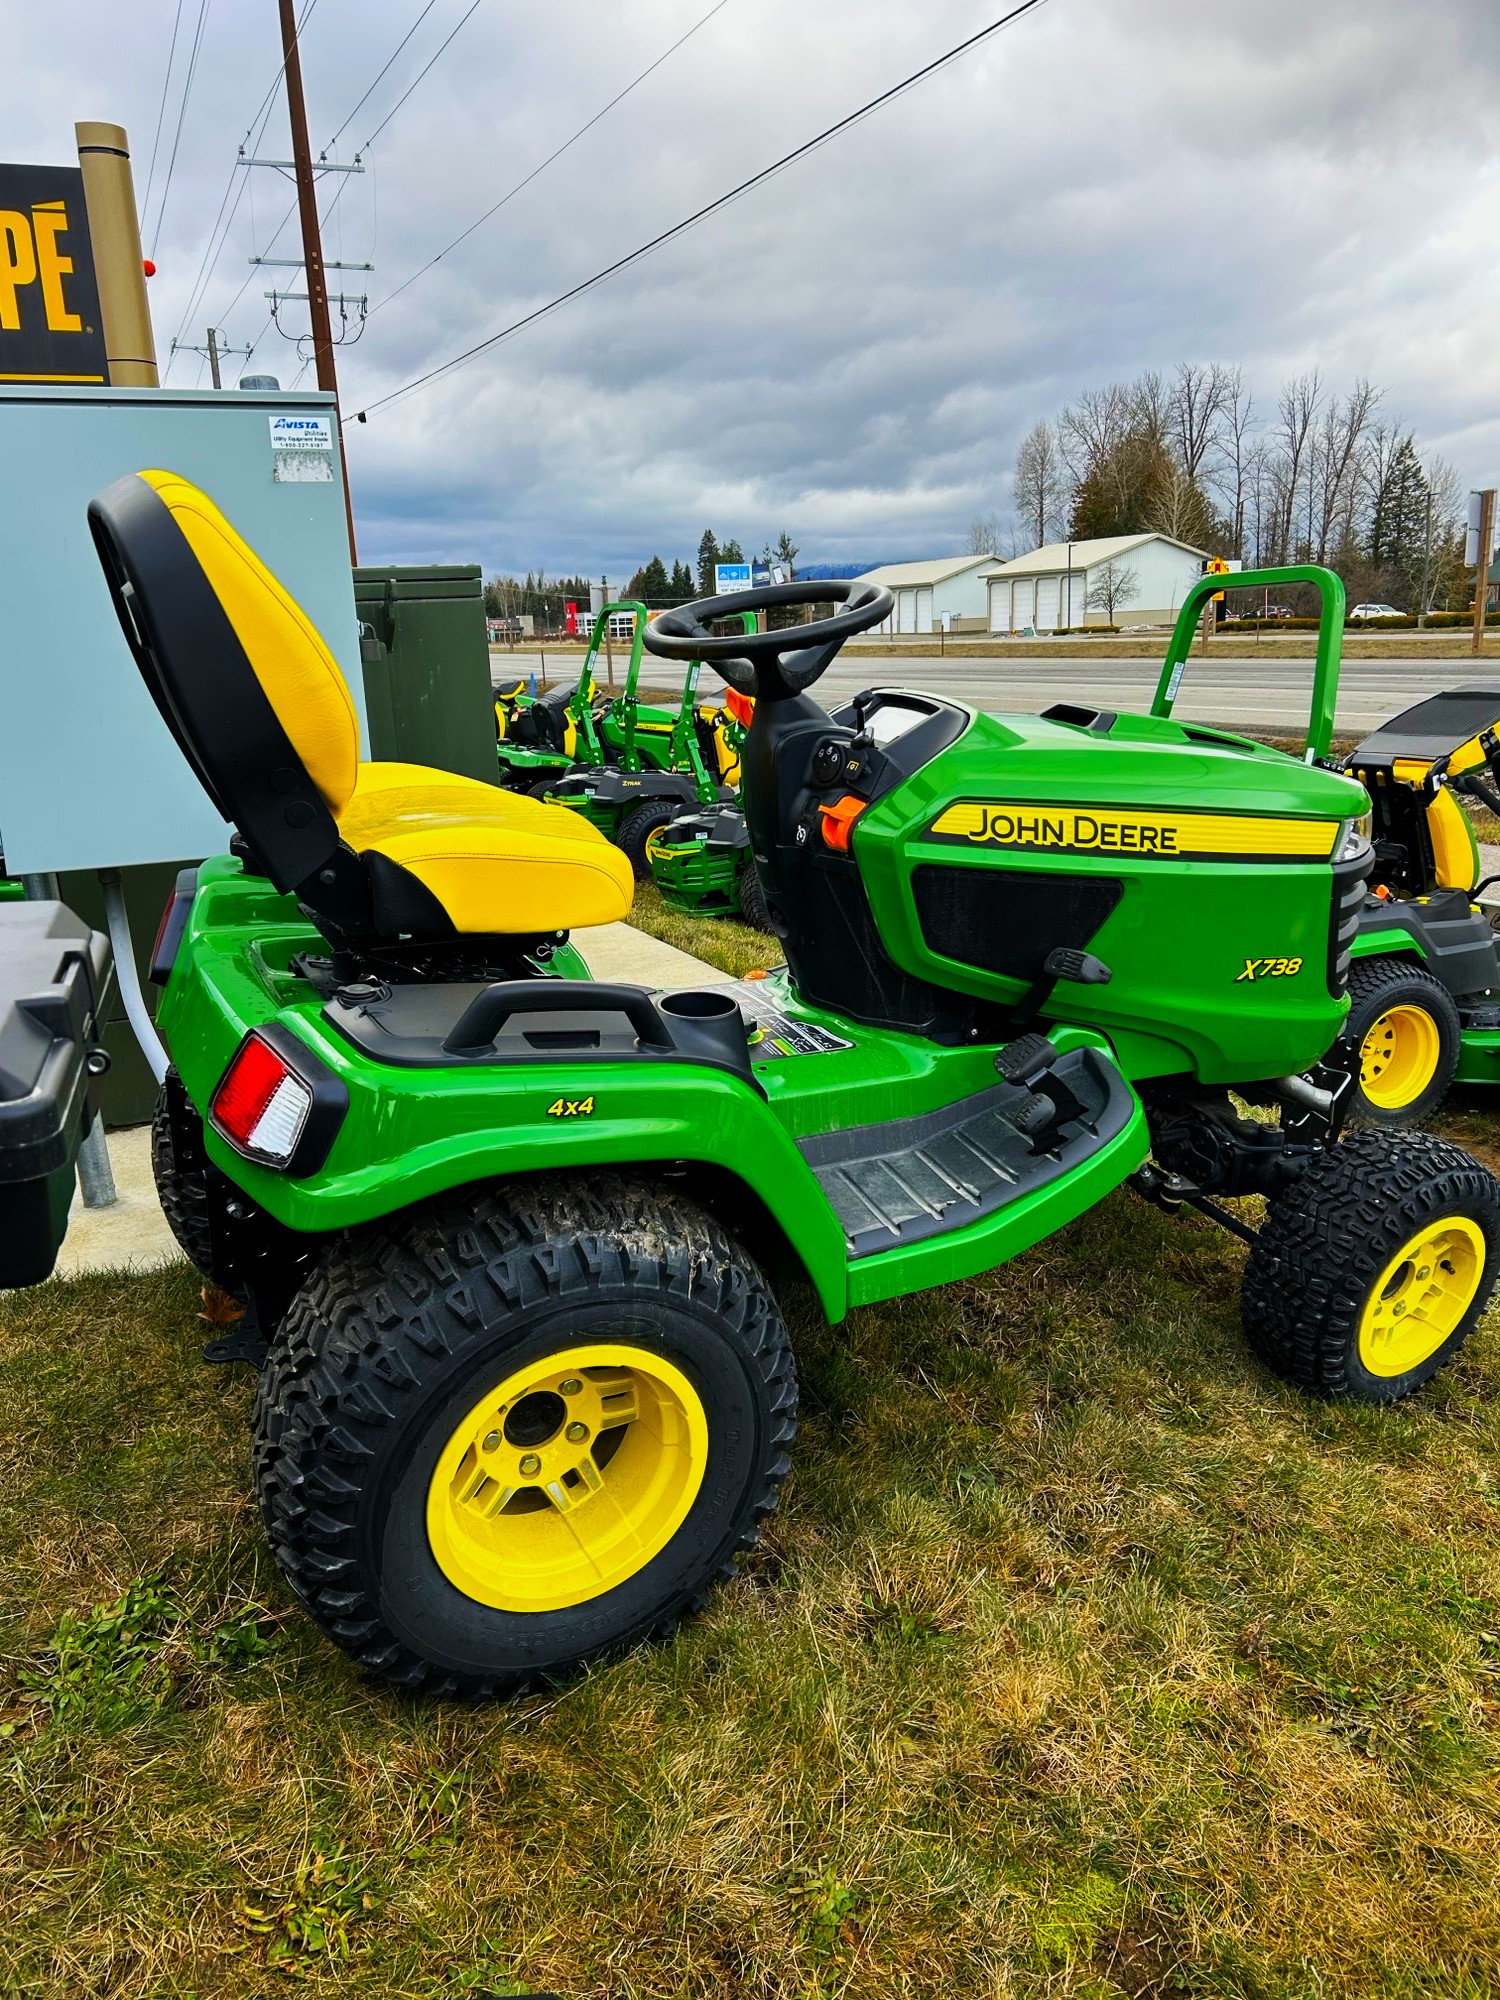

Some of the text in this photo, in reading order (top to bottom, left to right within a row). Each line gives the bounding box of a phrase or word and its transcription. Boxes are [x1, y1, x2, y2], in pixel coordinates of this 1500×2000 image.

[274, 418, 319, 429] AVISTA
[970, 808, 1178, 850] JOHN DEERE
[1235, 957, 1304, 981] X738
[547, 1096, 594, 1117] 4x4
